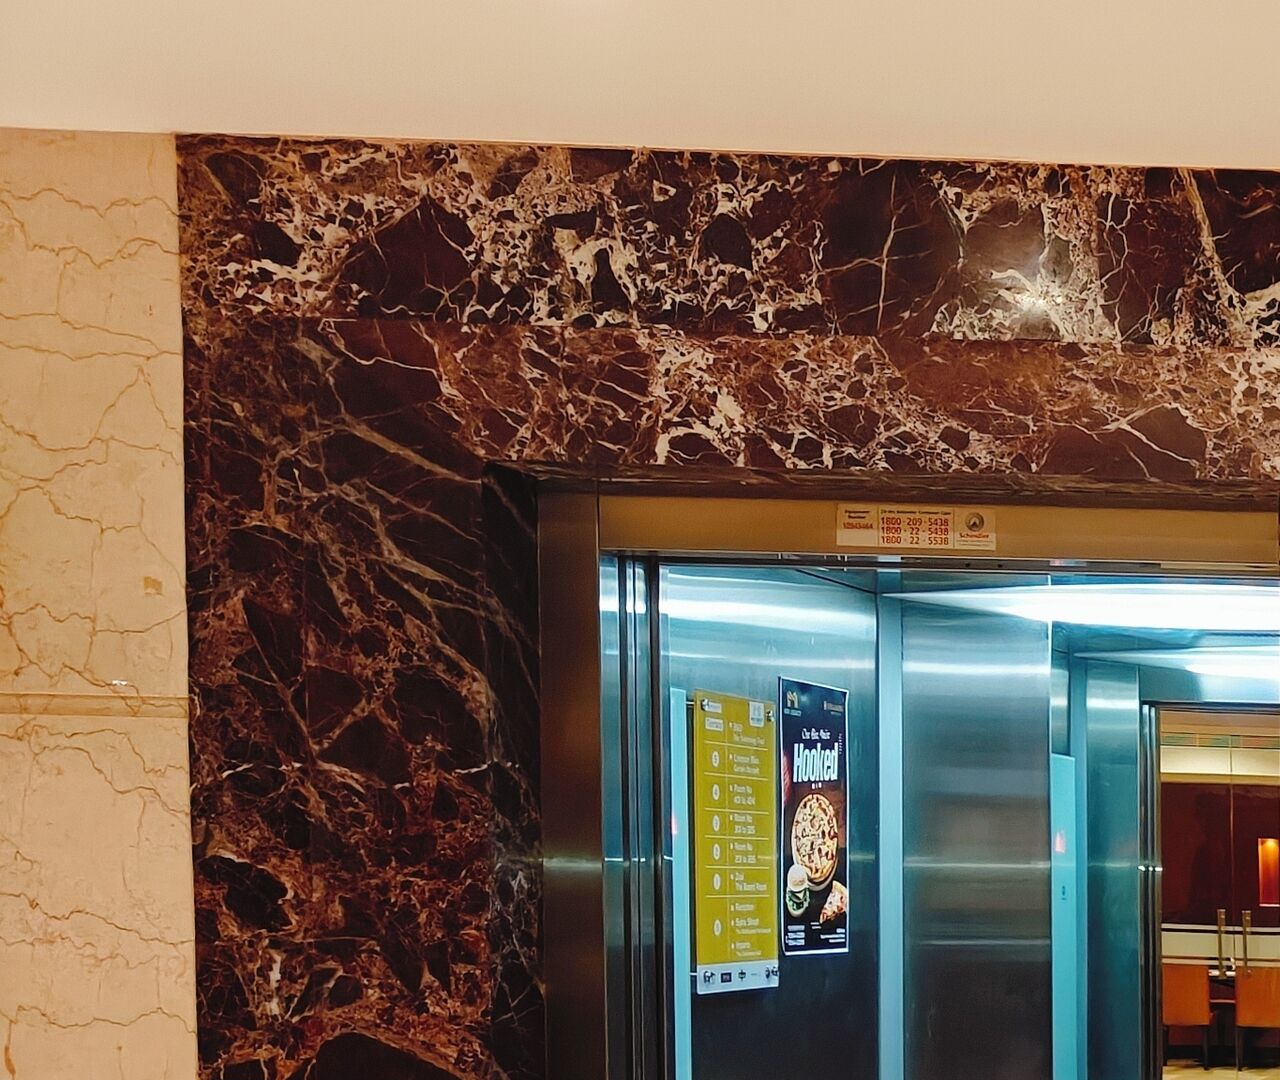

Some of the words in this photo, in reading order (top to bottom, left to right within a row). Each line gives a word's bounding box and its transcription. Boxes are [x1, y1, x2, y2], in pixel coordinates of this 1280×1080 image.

[881, 517, 902, 526] 1800
[906, 517, 922, 526] 209
[928, 518, 949, 527] 5438
[881, 526, 902, 535] 1800
[909, 527, 920, 535] 22
[928, 527, 949, 536] 5438
[881, 536, 902, 544] 1800
[909, 536, 920, 545] 22
[928, 536, 949, 546] 5538
[792, 742, 839, 783] Hooked
